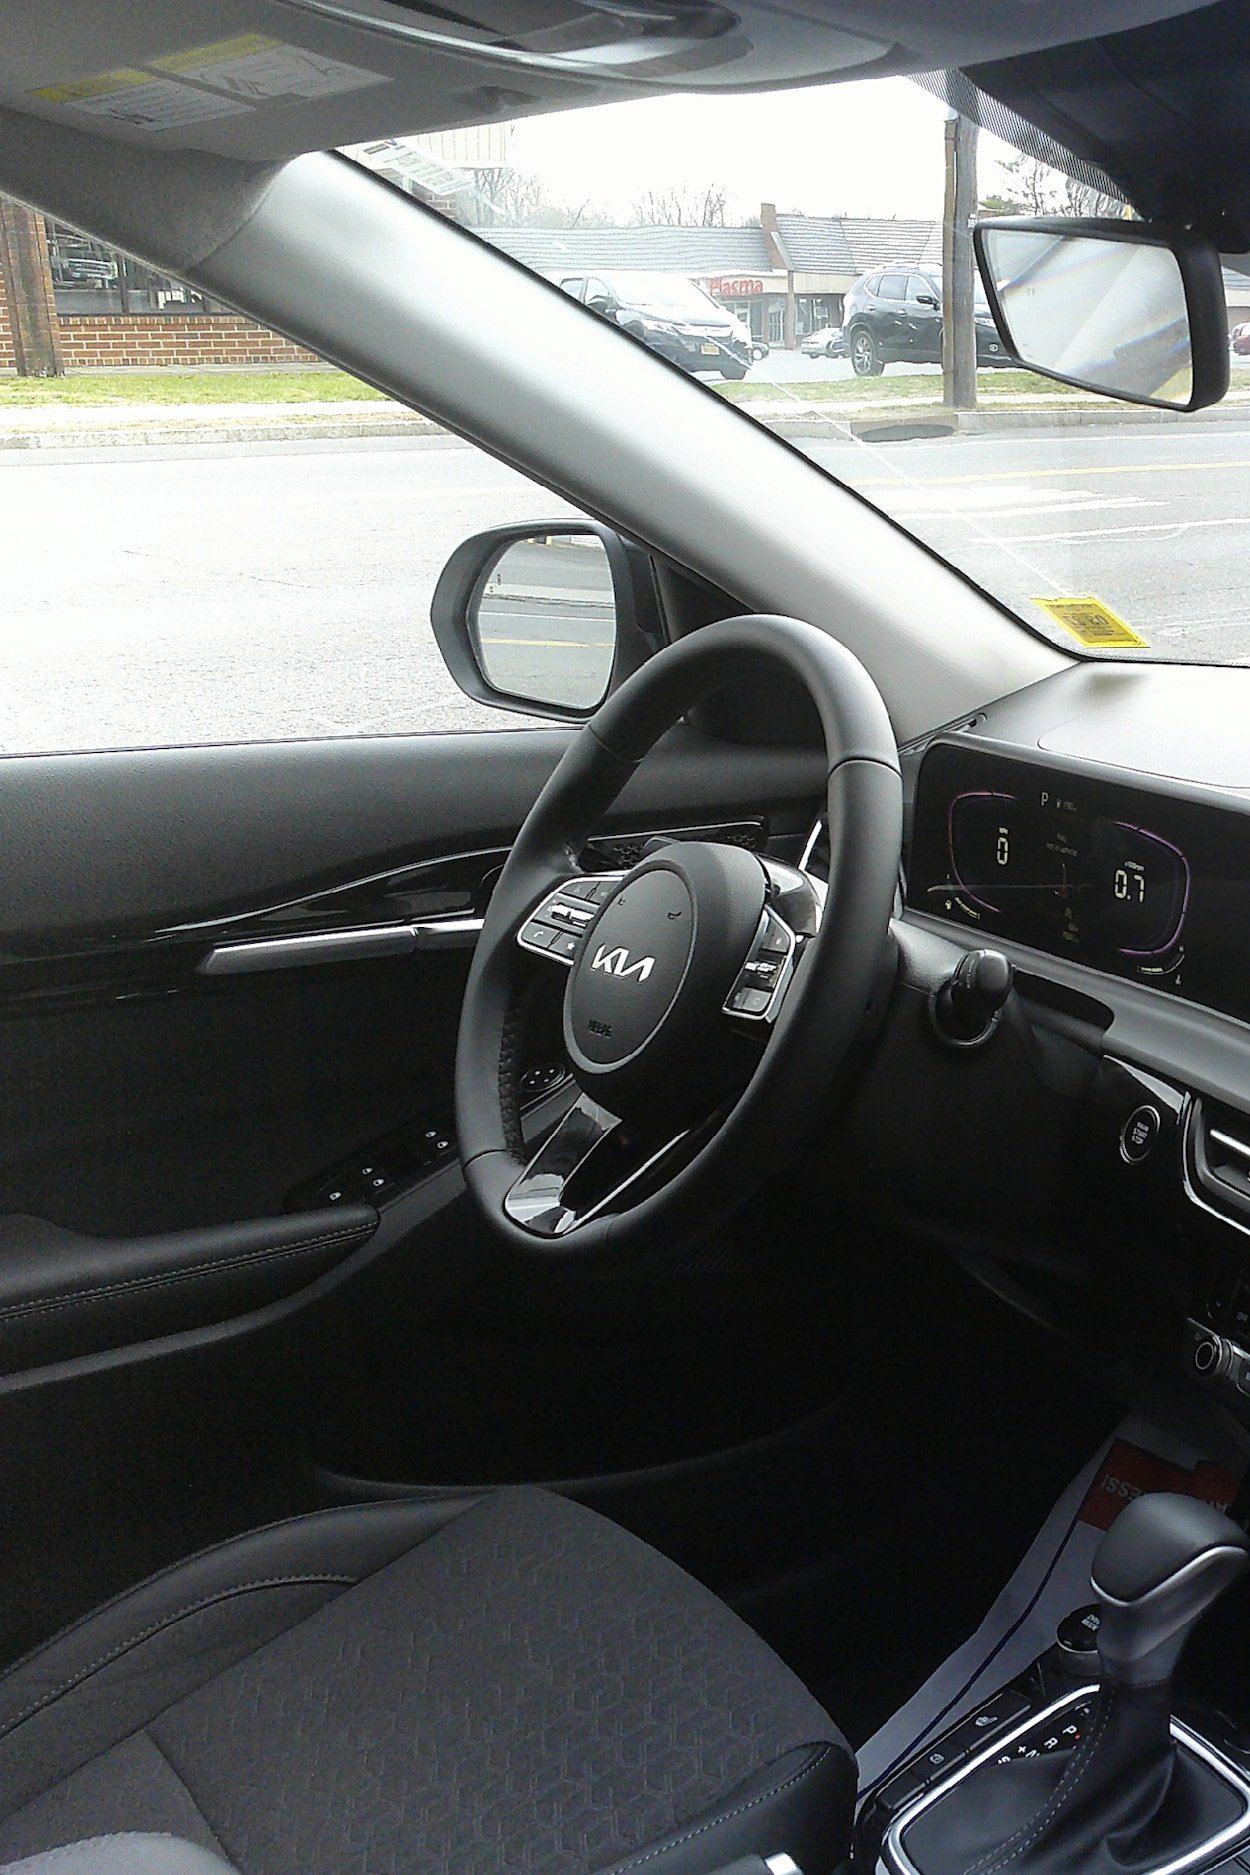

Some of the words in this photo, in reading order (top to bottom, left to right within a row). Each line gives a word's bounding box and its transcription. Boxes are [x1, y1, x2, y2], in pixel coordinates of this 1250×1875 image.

[1041, 791, 1050, 806] P
[996, 836, 1009, 866] 0
[1114, 869, 1145, 903] 0.7
